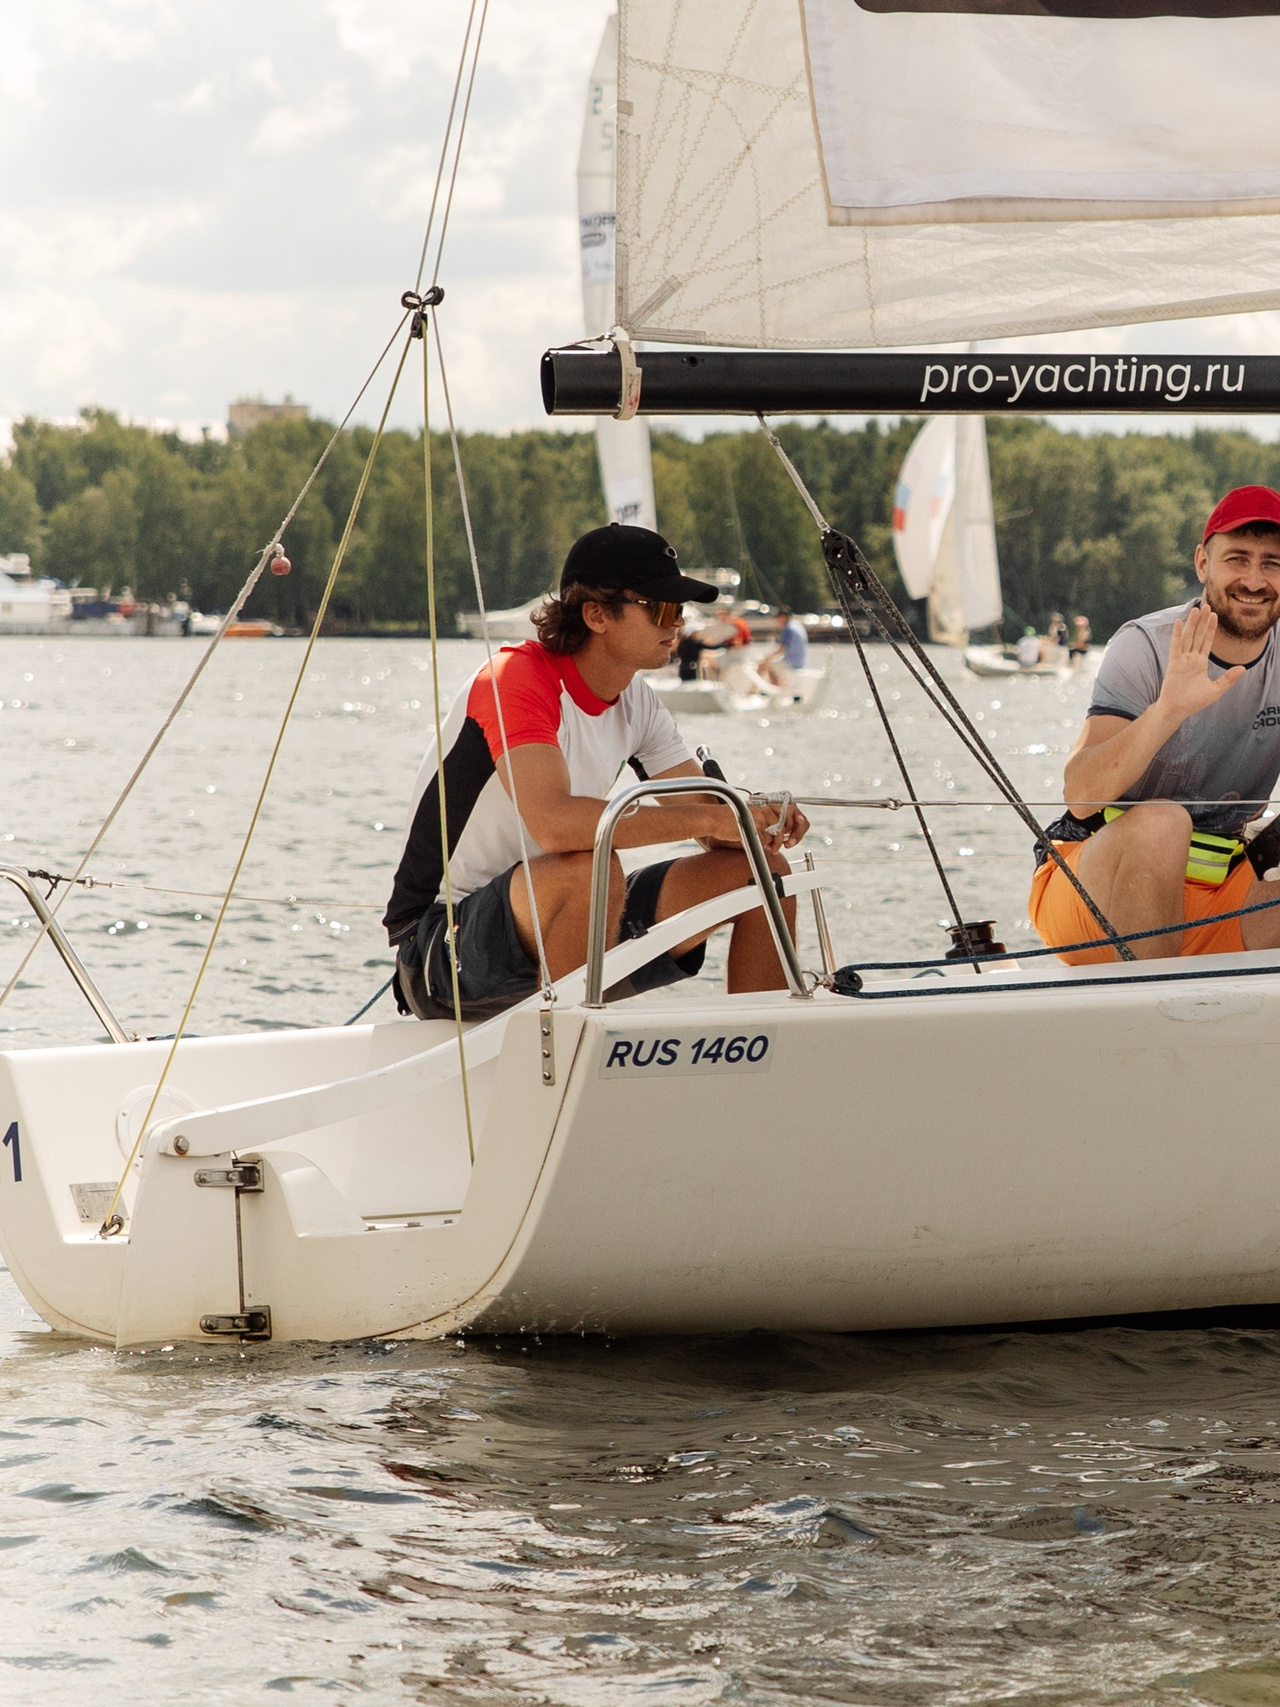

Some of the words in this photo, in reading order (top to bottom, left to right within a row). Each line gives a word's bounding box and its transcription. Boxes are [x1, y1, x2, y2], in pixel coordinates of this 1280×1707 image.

[920, 356, 1246, 402] pro-yachting.ru
[606, 1038, 682, 1068] RUS
[691, 1035, 769, 1065] 1460
[3, 1121, 22, 1182] 1
